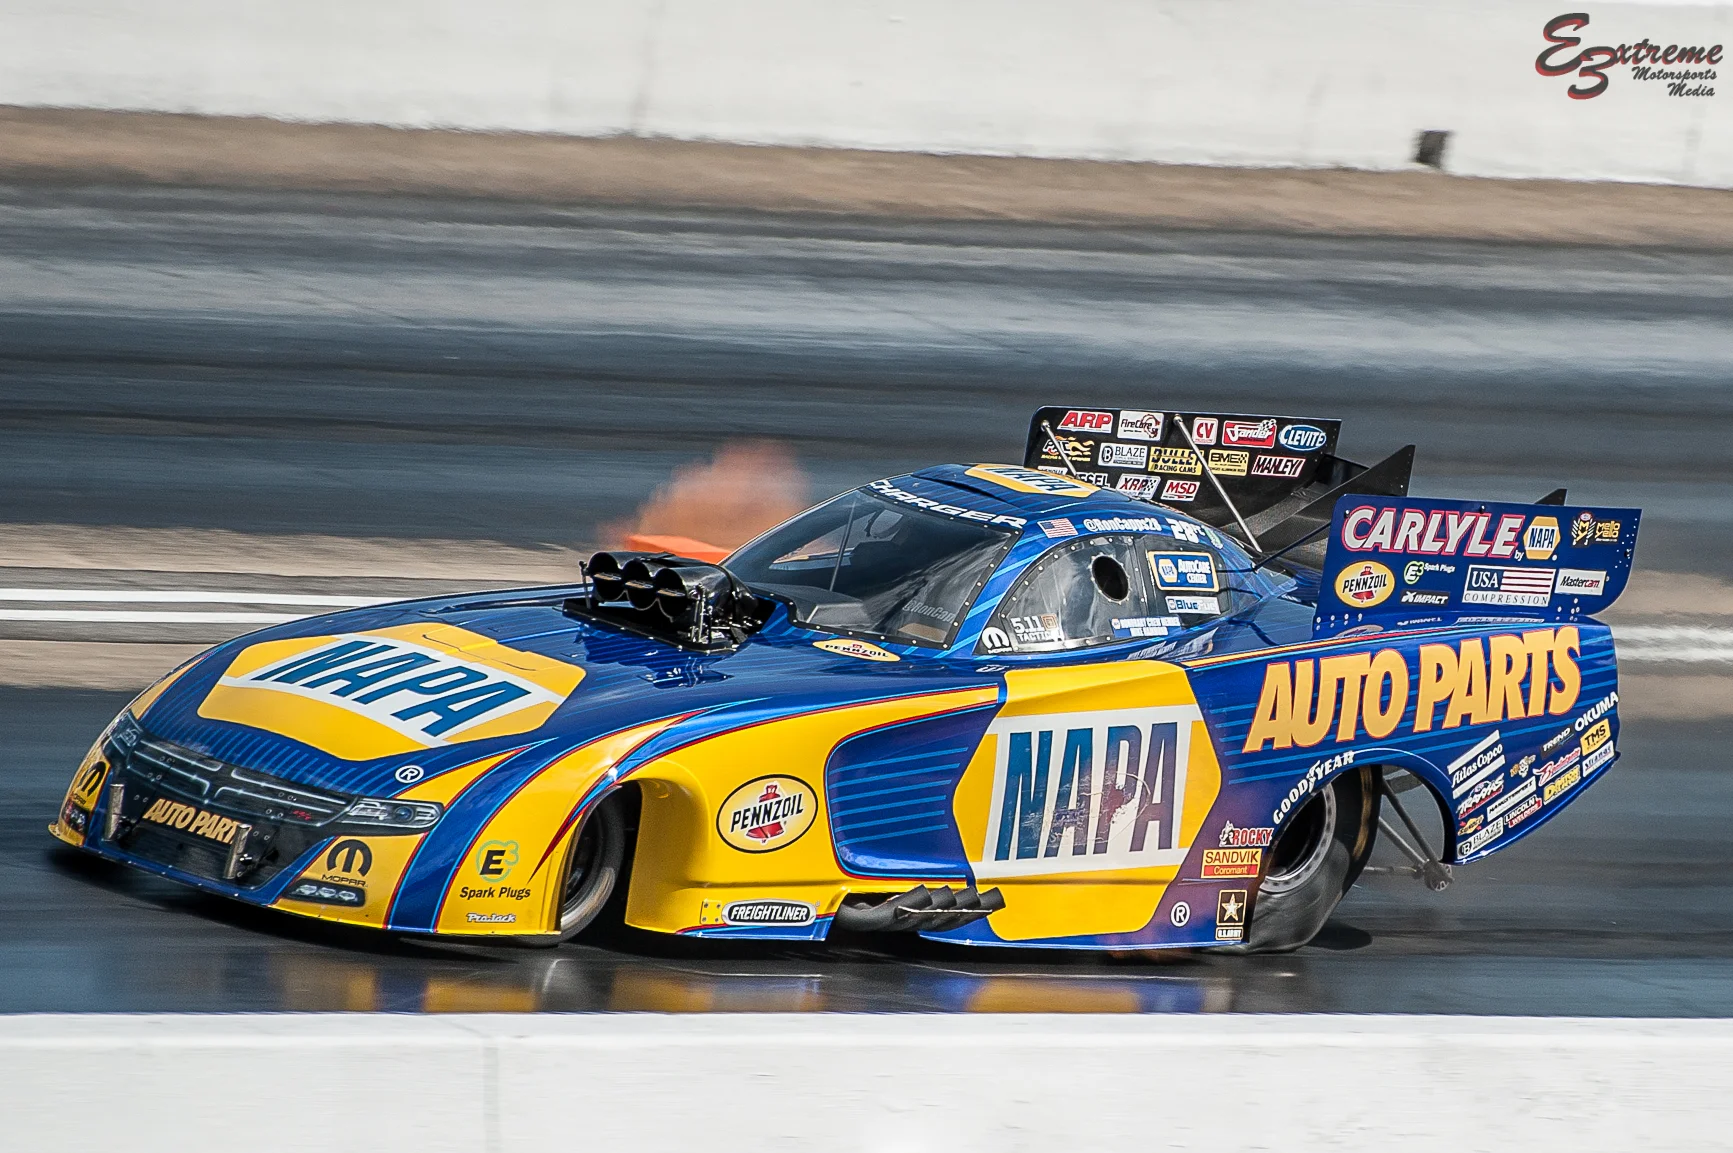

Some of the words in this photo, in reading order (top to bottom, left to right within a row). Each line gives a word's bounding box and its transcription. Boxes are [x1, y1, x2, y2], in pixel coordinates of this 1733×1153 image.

[1061, 411, 1112, 428] ARP
[1196, 422, 1215, 439] CV
[1279, 424, 1327, 446] CLEVITE
[1114, 446, 1145, 458] BLAZE
[1153, 464, 1178, 473] RACING
[1178, 465, 1197, 474] CAMS
[1253, 457, 1298, 476] MANLEY
[1119, 477, 1149, 491] XRP
[1166, 481, 1197, 494] MSD
[870, 479, 1028, 529] CHARGER
[1342, 505, 1526, 559] CARLYLE
[1514, 549, 1525, 562] by
[1528, 527, 1555, 549] NAPA
[1341, 573, 1387, 593] PENNZOIL
[1471, 571, 1499, 588] USA
[1560, 576, 1601, 588] Mastercam
[1464, 592, 1549, 606] COMPRESSION
[825, 644, 889, 658] PENNZOIL
[251, 640, 532, 738] NAPA
[1242, 648, 1410, 754] AUTO
[1413, 625, 1583, 733] PARTS
[1574, 691, 1619, 732] OKUMA
[1543, 727, 1571, 752] TREND
[1584, 724, 1606, 746] TMS
[1451, 760, 1478, 788] Atlas
[1476, 743, 1503, 769] Copco
[994, 721, 1179, 862] NAPA
[1273, 750, 1355, 825] GOODYEAR
[731, 793, 804, 833] PENNZOIL
[1506, 796, 1536, 822] LINCOLN
[143, 798, 197, 829] AUTO
[188, 810, 240, 844] PART
[1232, 827, 1274, 847] ROCKY
[1205, 850, 1260, 864] SANDVIK
[321, 873, 366, 888] MOPAR
[1213, 866, 1248, 875] Coromant
[459, 886, 496, 900] Spark
[498, 886, 531, 900] Plugs
[730, 904, 808, 921] FREIGHTLINER
